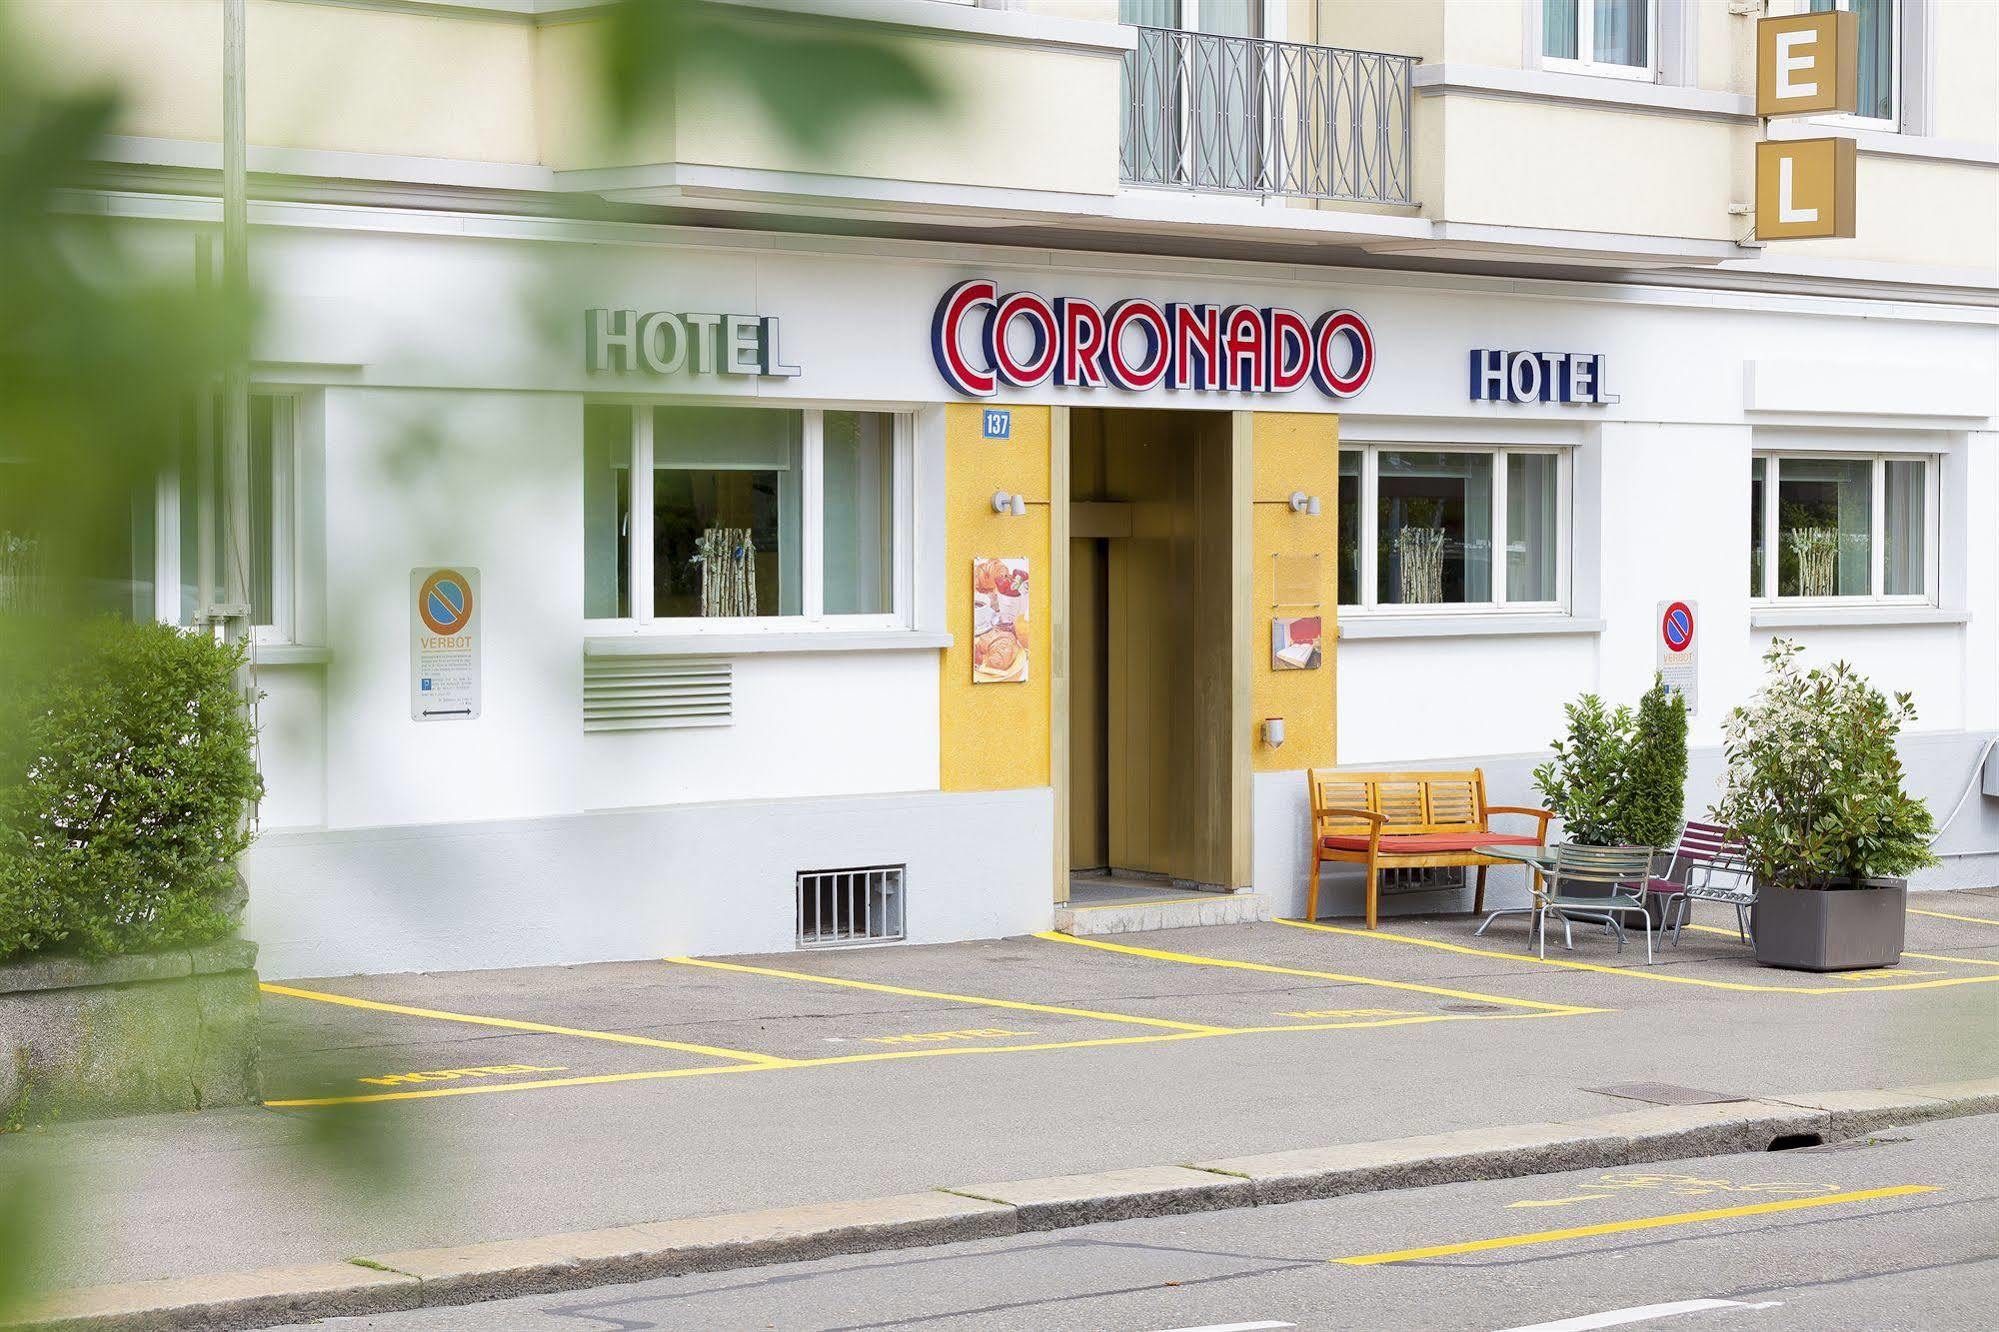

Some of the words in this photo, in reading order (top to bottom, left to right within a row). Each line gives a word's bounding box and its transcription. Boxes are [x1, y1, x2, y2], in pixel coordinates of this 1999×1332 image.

[585, 308, 801, 377] HOTEL
[931, 278, 1376, 400] CORONADO
[1470, 349, 1621, 404] HOTEL
[987, 414, 1008, 435] 137
[421, 636, 472, 649] VERBOT
[1663, 652, 1693, 663] VERBOT
[357, 1064, 570, 1086] HOTEL
